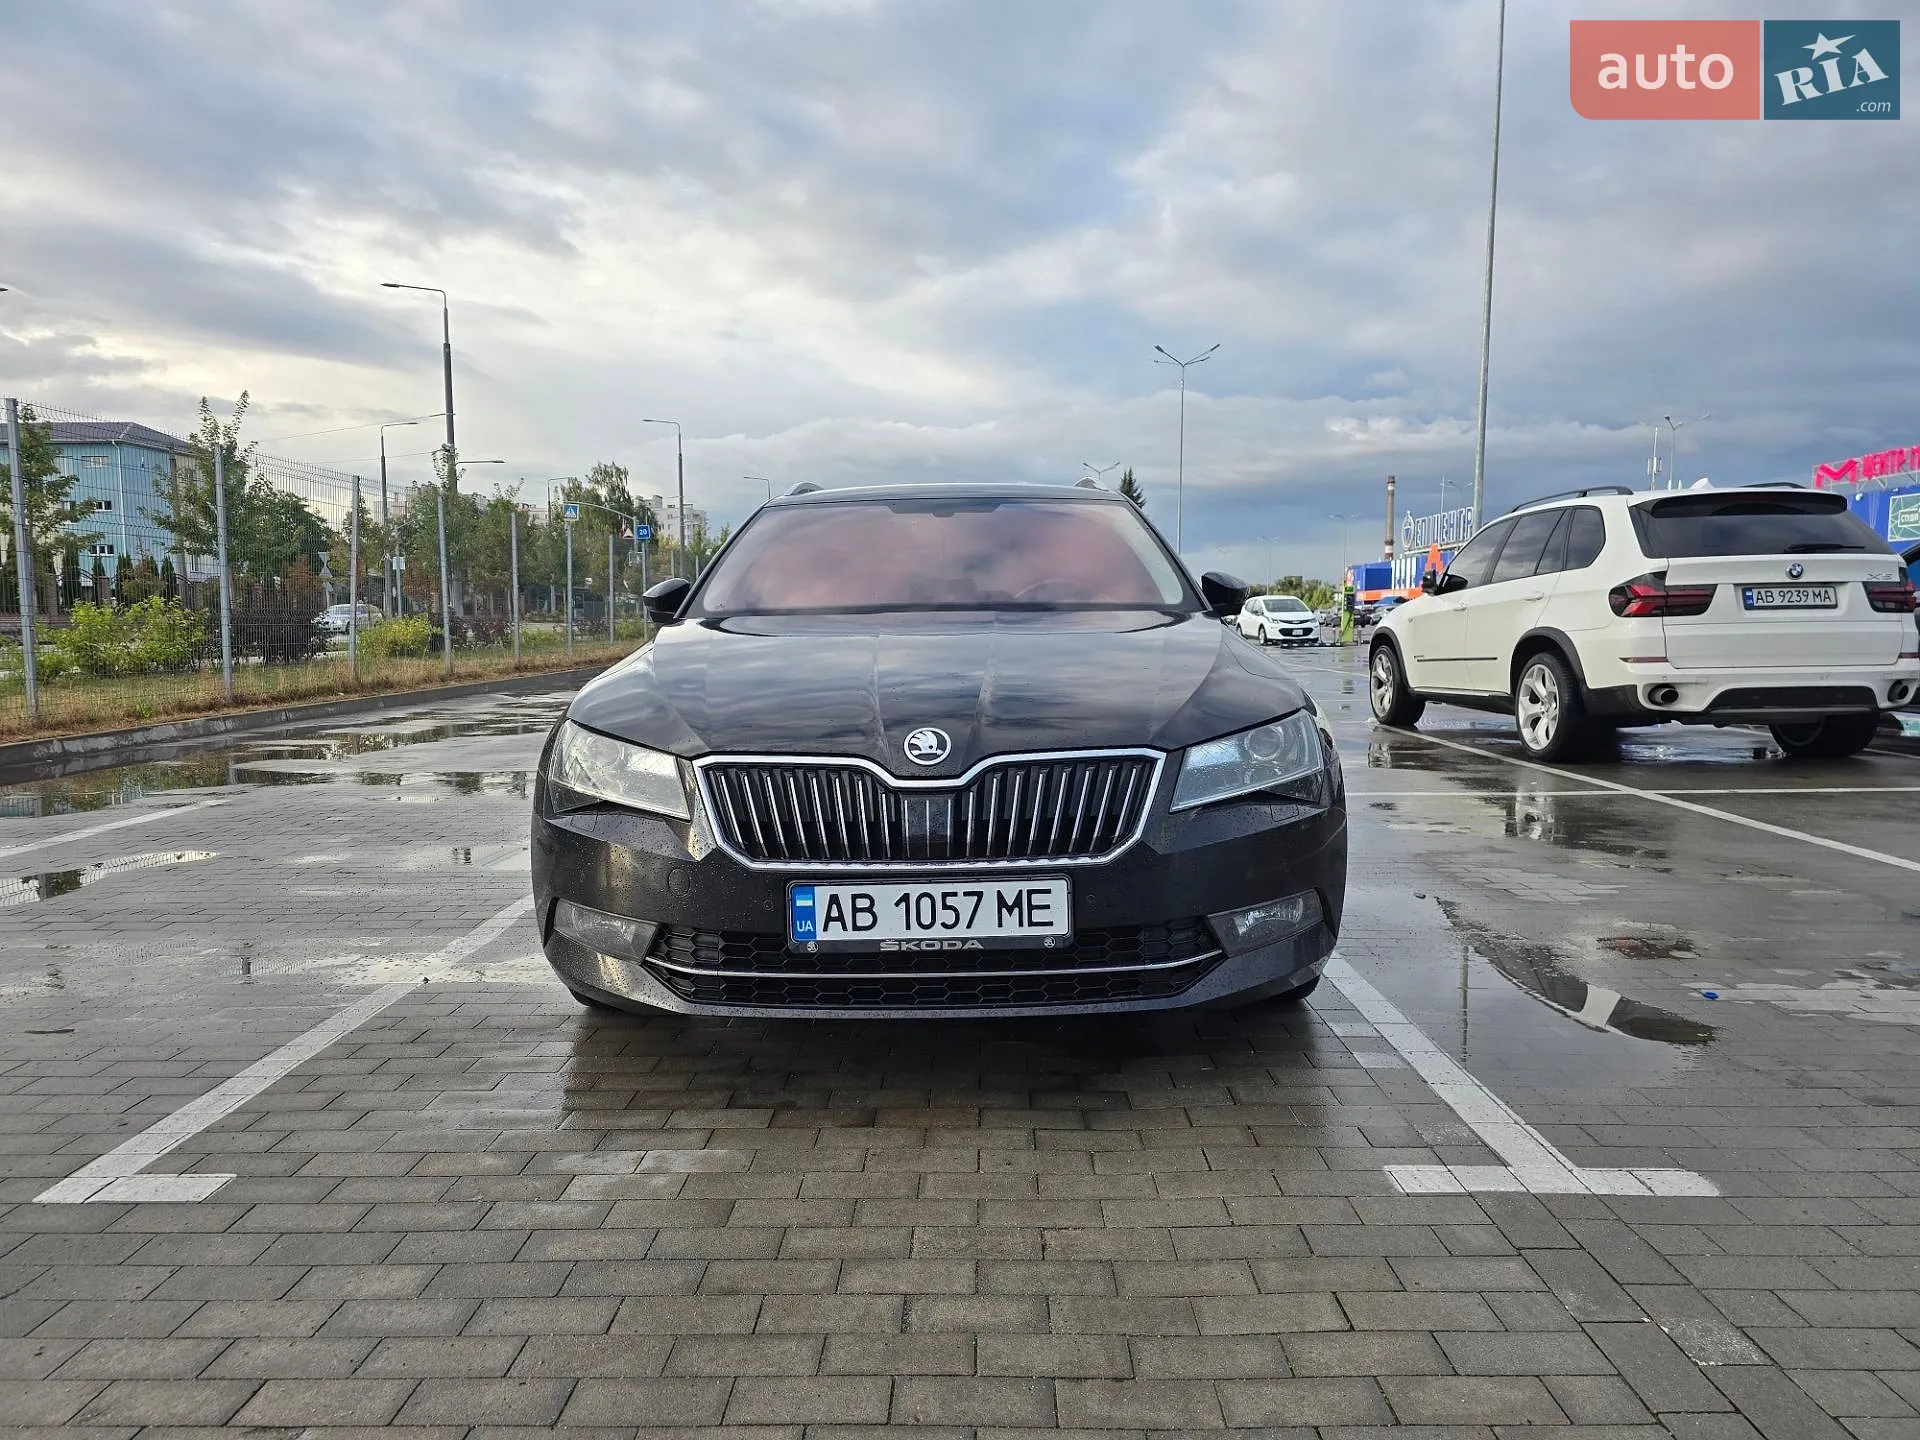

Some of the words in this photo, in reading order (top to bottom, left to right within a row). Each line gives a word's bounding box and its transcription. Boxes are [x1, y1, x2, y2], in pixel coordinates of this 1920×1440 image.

[1756, 590, 1775, 604] AB
[1778, 590, 1810, 603] 9239
[1812, 589, 1832, 603] MA
[822, 893, 878, 933] AB
[894, 890, 984, 931] 1057
[996, 888, 1054, 928] ME
[796, 920, 814, 932] UA
